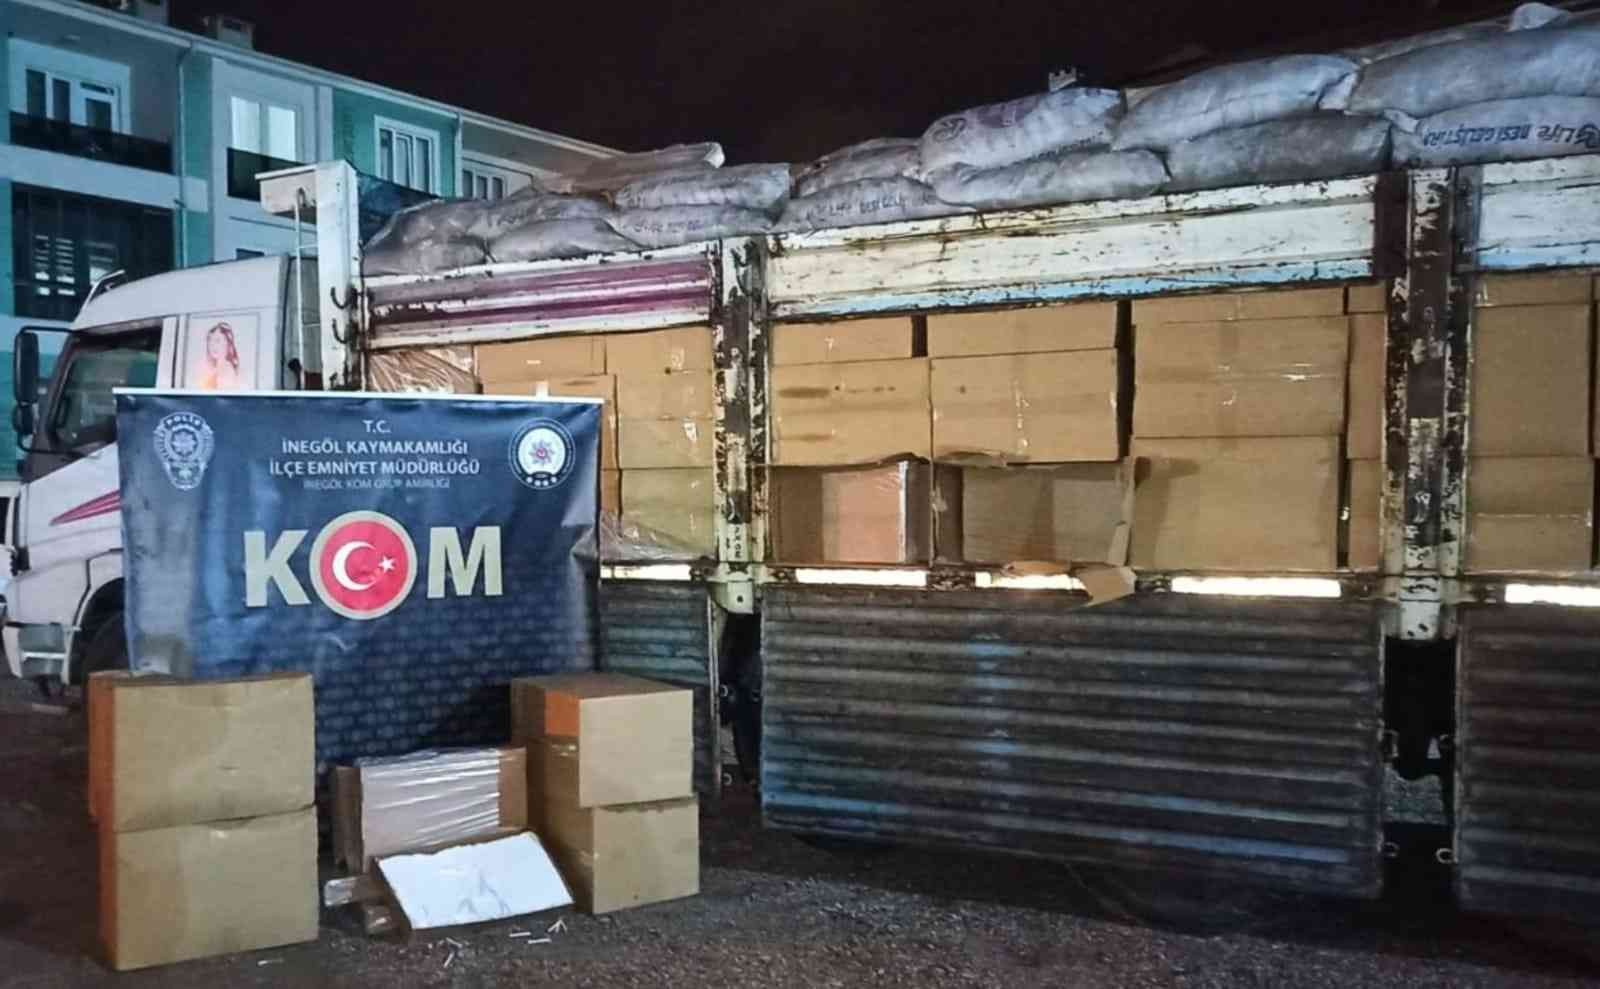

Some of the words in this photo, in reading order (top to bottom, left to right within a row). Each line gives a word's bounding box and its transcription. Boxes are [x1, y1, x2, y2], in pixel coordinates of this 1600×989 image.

[362, 420, 391, 433] T.C.
[281, 438, 343, 454] İNEGÖL
[346, 438, 468, 454] KAYMAKAMLIĞI
[269, 458, 302, 477] İLÇE
[307, 458, 378, 475] EMNİYET
[381, 458, 481, 475] MÜDÜRLÜĞÜ
